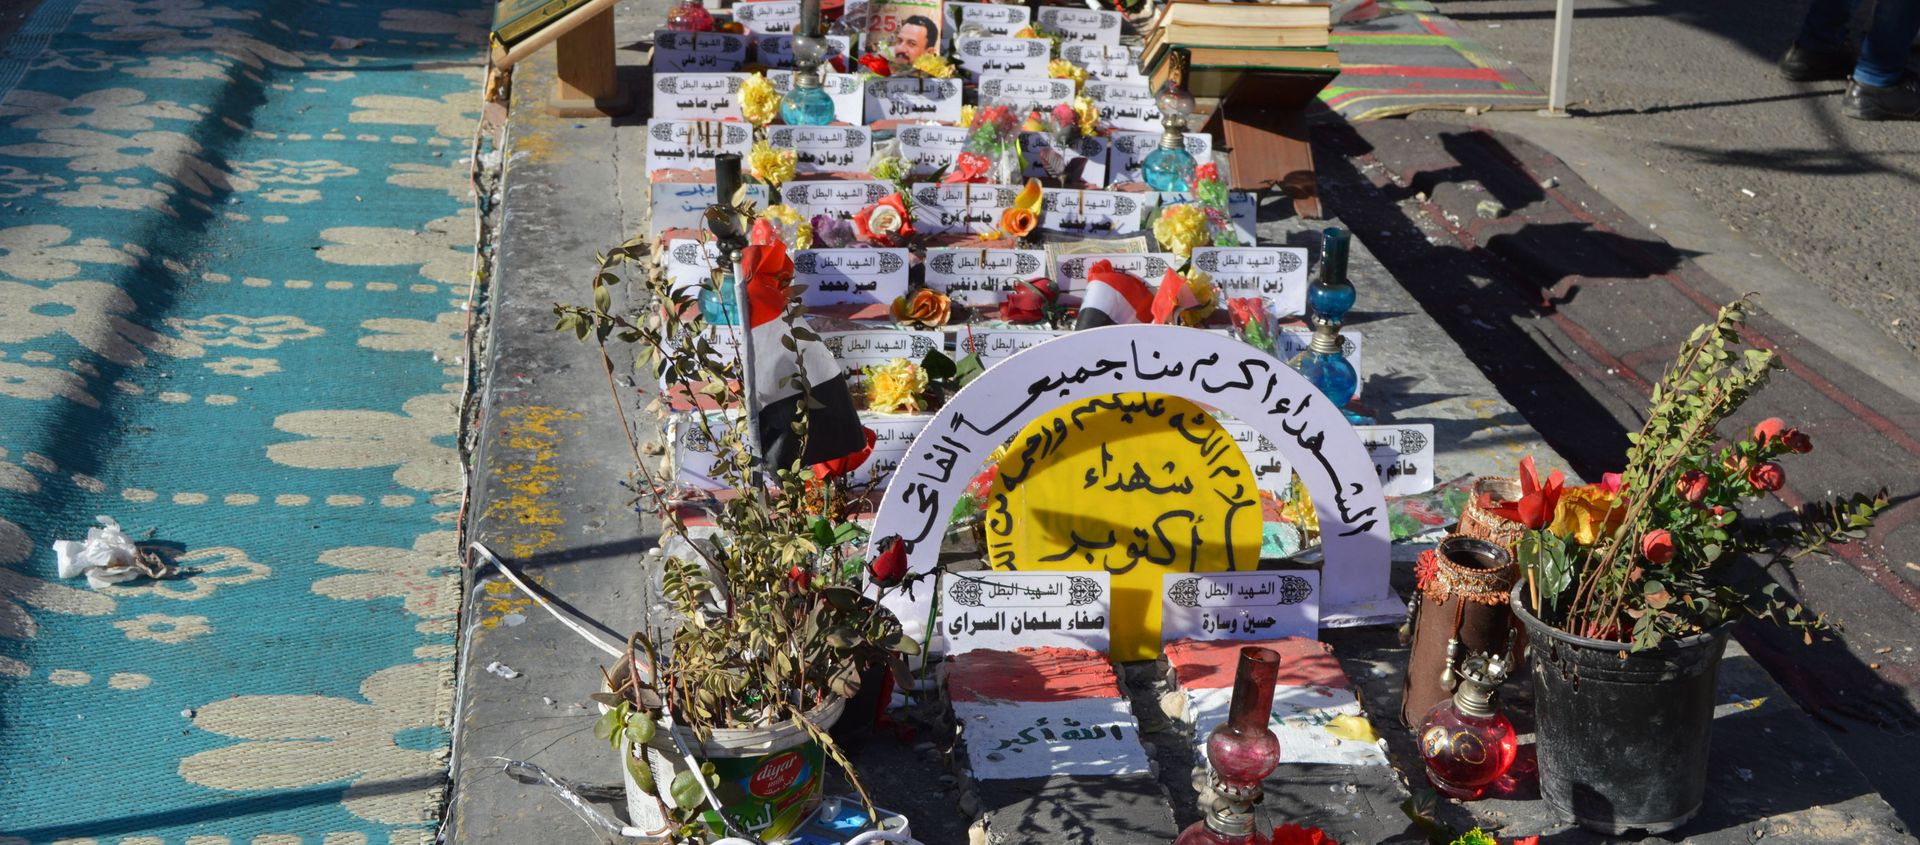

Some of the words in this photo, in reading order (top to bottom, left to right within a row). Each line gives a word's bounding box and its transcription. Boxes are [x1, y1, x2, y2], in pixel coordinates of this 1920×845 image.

[765, 20, 791, 32] فاطمة
[869, 15, 896, 32] 25
[680, 79, 698, 90] البطل
[701, 80, 725, 91] الشهيد
[676, 97, 708, 111] صاحب
[711, 97, 730, 114] علي
[911, 102, 937, 113] محمد
[796, 132, 815, 143] البطل
[817, 132, 842, 144] الشهيد
[924, 131, 943, 144] البطل
[654, 148, 685, 161] حبيب
[818, 150, 854, 166] نورمان
[812, 187, 833, 200] البطل
[836, 188, 863, 200] الشهيد
[942, 190, 963, 203] البطل
[1084, 198, 1111, 210] الشهيد
[820, 256, 843, 269] البطل
[846, 256, 876, 269] الشهيد
[958, 256, 980, 270] البطل
[1222, 254, 1244, 267] البطل
[1246, 255, 1275, 268] الشهيد
[818, 279, 850, 292] محمد
[852, 280, 878, 295] صبر
[980, 276, 999, 291] الله
[1263, 276, 1284, 293] زين
[847, 338, 871, 353] البطل
[874, 338, 907, 353] الشهيد
[991, 338, 1016, 353] البطل
[1083, 441, 1195, 494] شهداء
[1255, 456, 1282, 481] علي
[1037, 509, 1205, 575] أكتوبر
[988, 582, 1018, 600] البطل
[1023, 582, 1063, 600] الشهيد
[1205, 581, 1233, 600] البطل
[1237, 581, 1275, 600] الشهيد
[948, 611, 1006, 641] السراي
[1010, 610, 1062, 635] سلمان
[1066, 610, 1105, 631] صفاء
[1202, 613, 1238, 634] وسارة
[1242, 613, 1277, 634] حسين
[1061, 717, 1123, 741] الله
[756, 757, 794, 781] diyar
